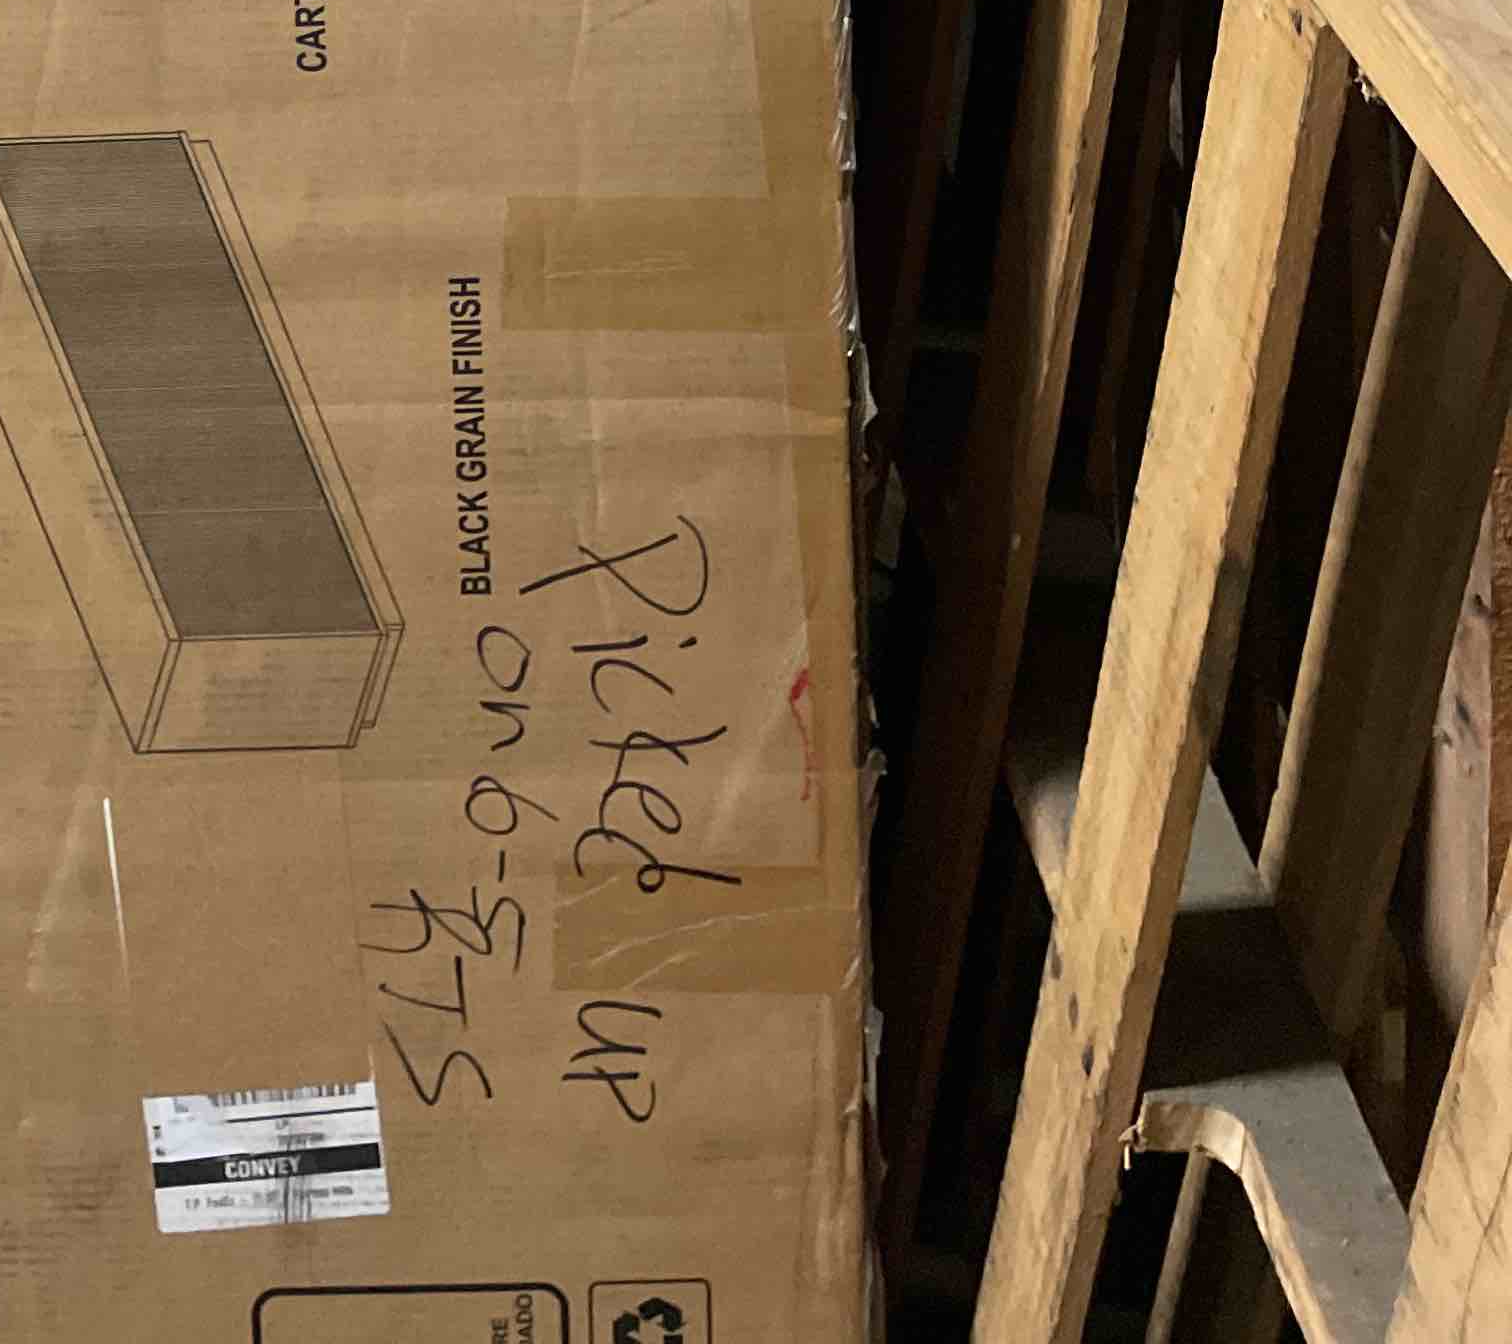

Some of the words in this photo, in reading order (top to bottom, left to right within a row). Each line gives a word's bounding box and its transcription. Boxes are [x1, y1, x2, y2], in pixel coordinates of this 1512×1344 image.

[448, 277, 483, 375] FINISH
[453, 387, 487, 482] GRAIN
[457, 490, 491, 596] BLACK
[223, 1155, 303, 1179] CONVEY
